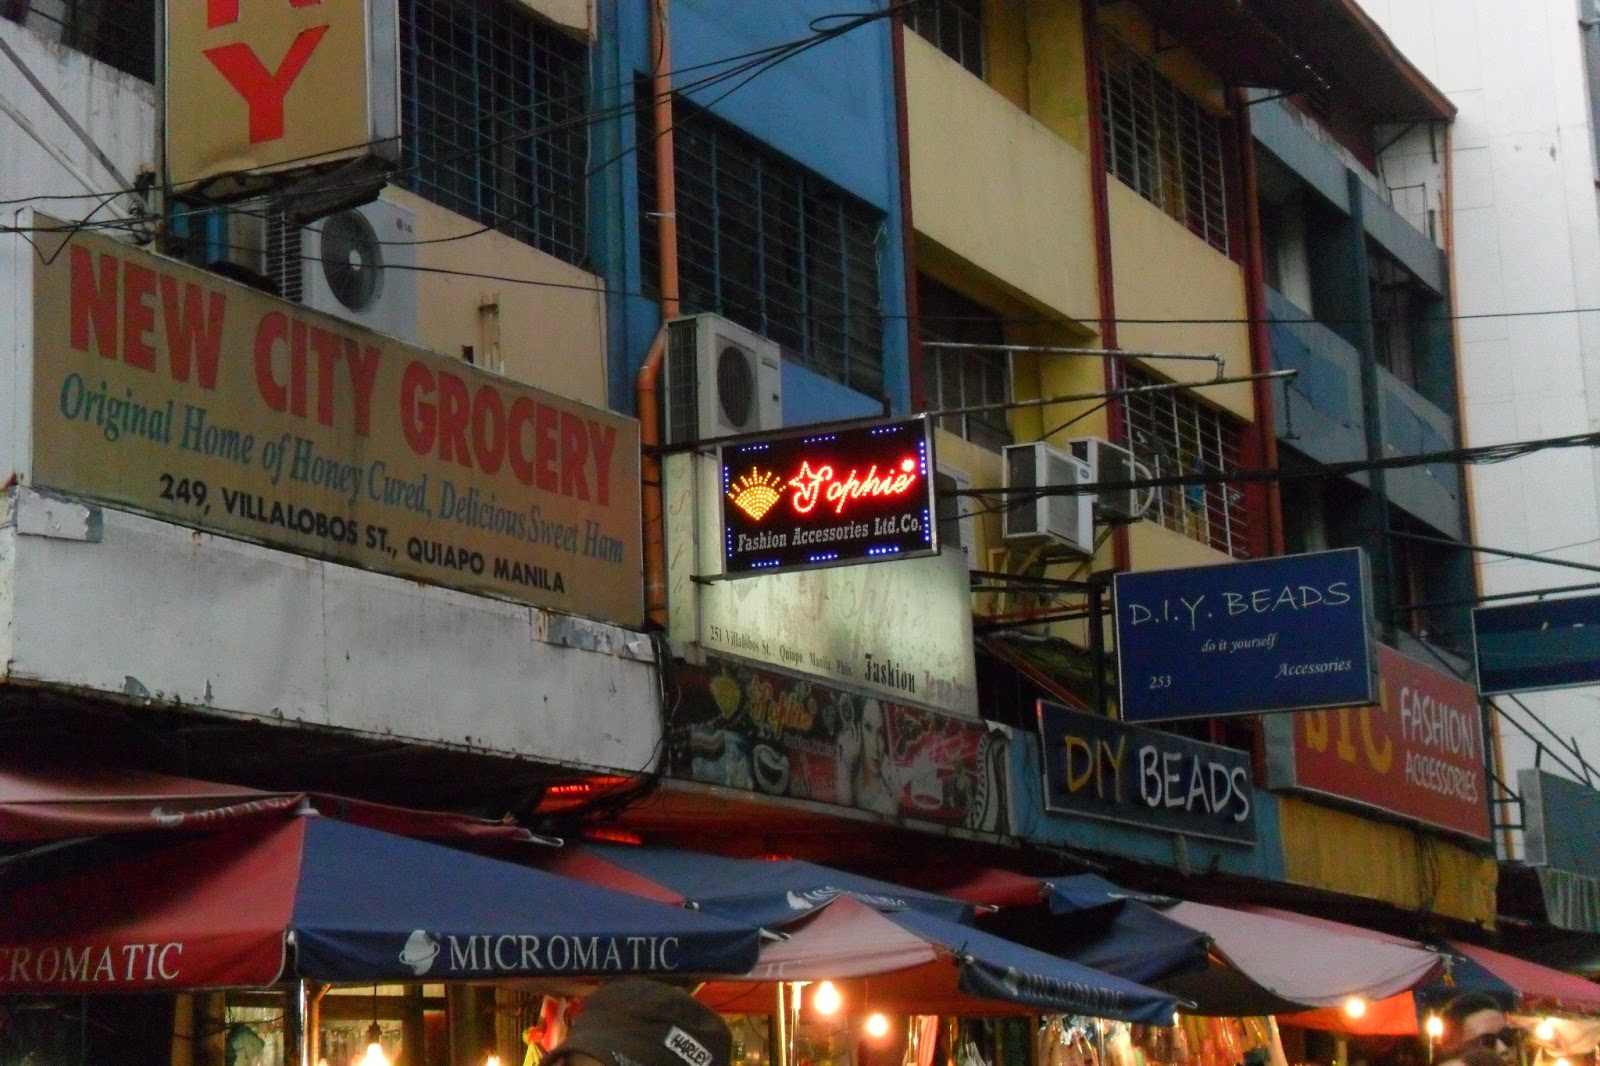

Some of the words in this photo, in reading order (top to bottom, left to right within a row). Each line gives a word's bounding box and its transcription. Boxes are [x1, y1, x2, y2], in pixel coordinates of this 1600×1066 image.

[203, 0, 330, 145] Y
[70, 243, 225, 389] NEW
[255, 311, 381, 437] CITY
[402, 362, 616, 507] GROCERY
[60, 372, 174, 442] Original
[179, 403, 255, 464] Home
[262, 432, 291, 486] of
[290, 437, 364, 506] Honey
[368, 460, 431, 521] Cured,
[438, 480, 526, 540] Delicious
[527, 505, 578, 554] Sweet
[584, 519, 625, 565] Ham
[789, 460, 916, 515] Sophie
[160, 473, 212, 515] 249,
[221, 486, 358, 545] VILLALOBOS
[366, 523, 398, 560] ST.,
[407, 536, 486, 576] QUIAPO
[494, 558, 565, 594] MANILA
[737, 530, 788, 553] Fashion
[792, 521, 869, 547] Accessories
[1129, 594, 1213, 632] D.I.Y.
[1222, 582, 1351, 616] BEADS
[710, 625, 723, 643] 251
[725, 629, 760, 652] Villalobos
[1202, 638, 1216, 652] do
[1218, 638, 1228, 651] it
[1229, 632, 1279, 654] yourself
[864, 652, 915, 694] Fashion
[1150, 675, 1172, 689] 253
[1275, 657, 1352, 679] Accessories
[1400, 687, 1474, 760] FASHION
[1064, 735, 1126, 804] DIY
[1139, 745, 1250, 822] BEADS
[1405, 750, 1480, 806] ACCESSORIES
[0, 942, 183, 982] ROMATIC
[448, 934, 679, 972] MICROMATIC
